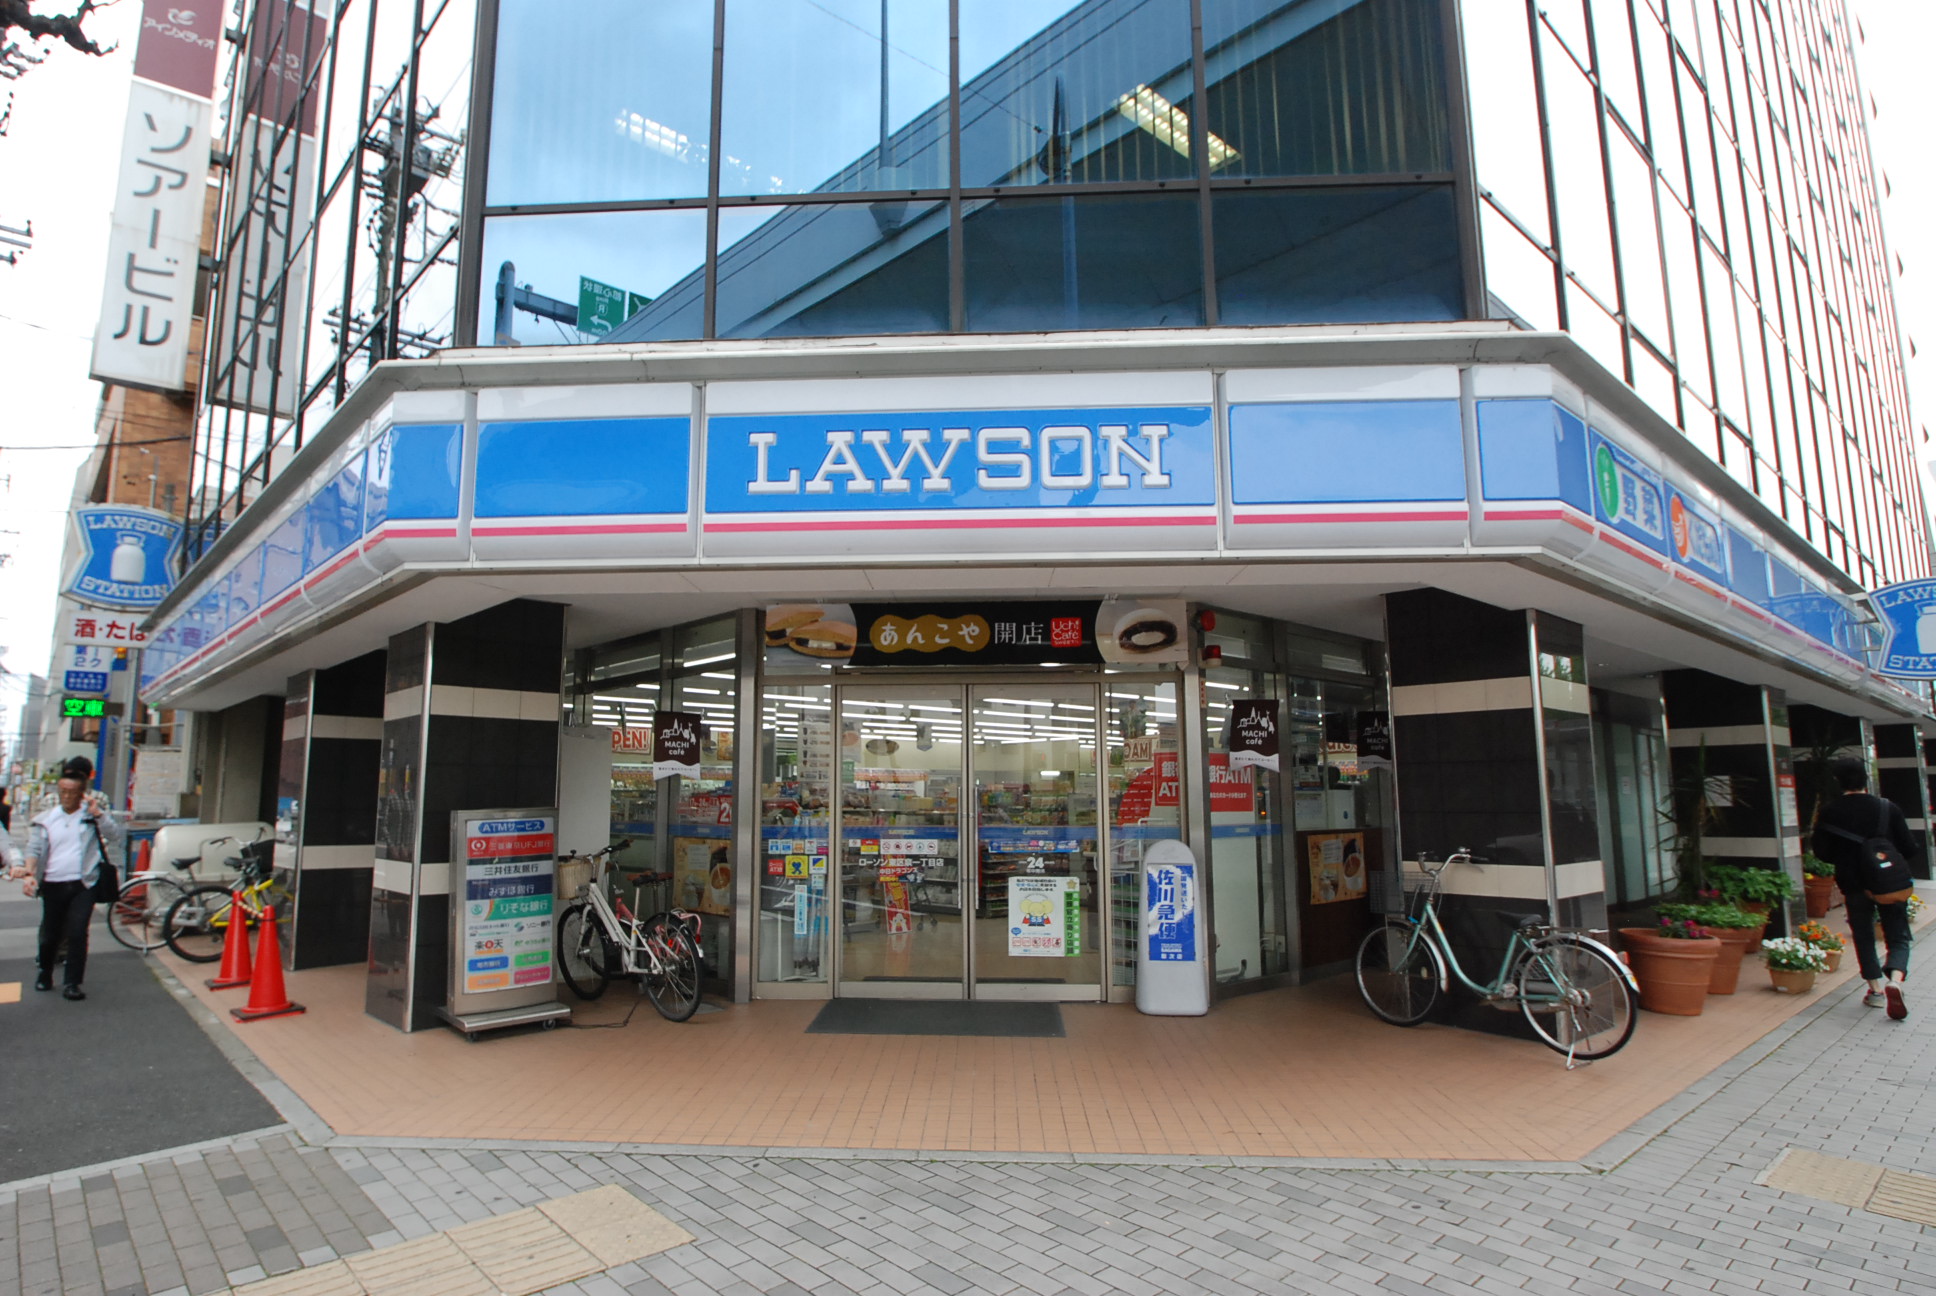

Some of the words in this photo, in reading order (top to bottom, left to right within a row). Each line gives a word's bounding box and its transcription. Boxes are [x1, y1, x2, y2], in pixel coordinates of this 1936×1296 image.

[113, 112, 193, 346] ソアービル
[747, 423, 1171, 494] LAWSON
[86, 515, 176, 539] LAWSON
[80, 575, 170, 599] STATION
[1880, 586, 1936, 608] LAW
[880, 622, 980, 645] あんこや
[994, 622, 1044, 645] 開店
[64, 698, 105, 717] 空車
[1241, 729, 1268, 738] MACHI
[664, 741, 689, 749] MACHI
[1245, 737, 1263, 745] café
[669, 748, 685, 756] café
[482, 821, 542, 832] ATMサービス
[1026, 856, 1045, 869] 24
[484, 863, 539, 876] 三井住友銀行
[488, 884, 535, 897] みずほ銀行
[500, 901, 548, 914] りそな銀行
[1157, 869, 1176, 939] 佐川急便
